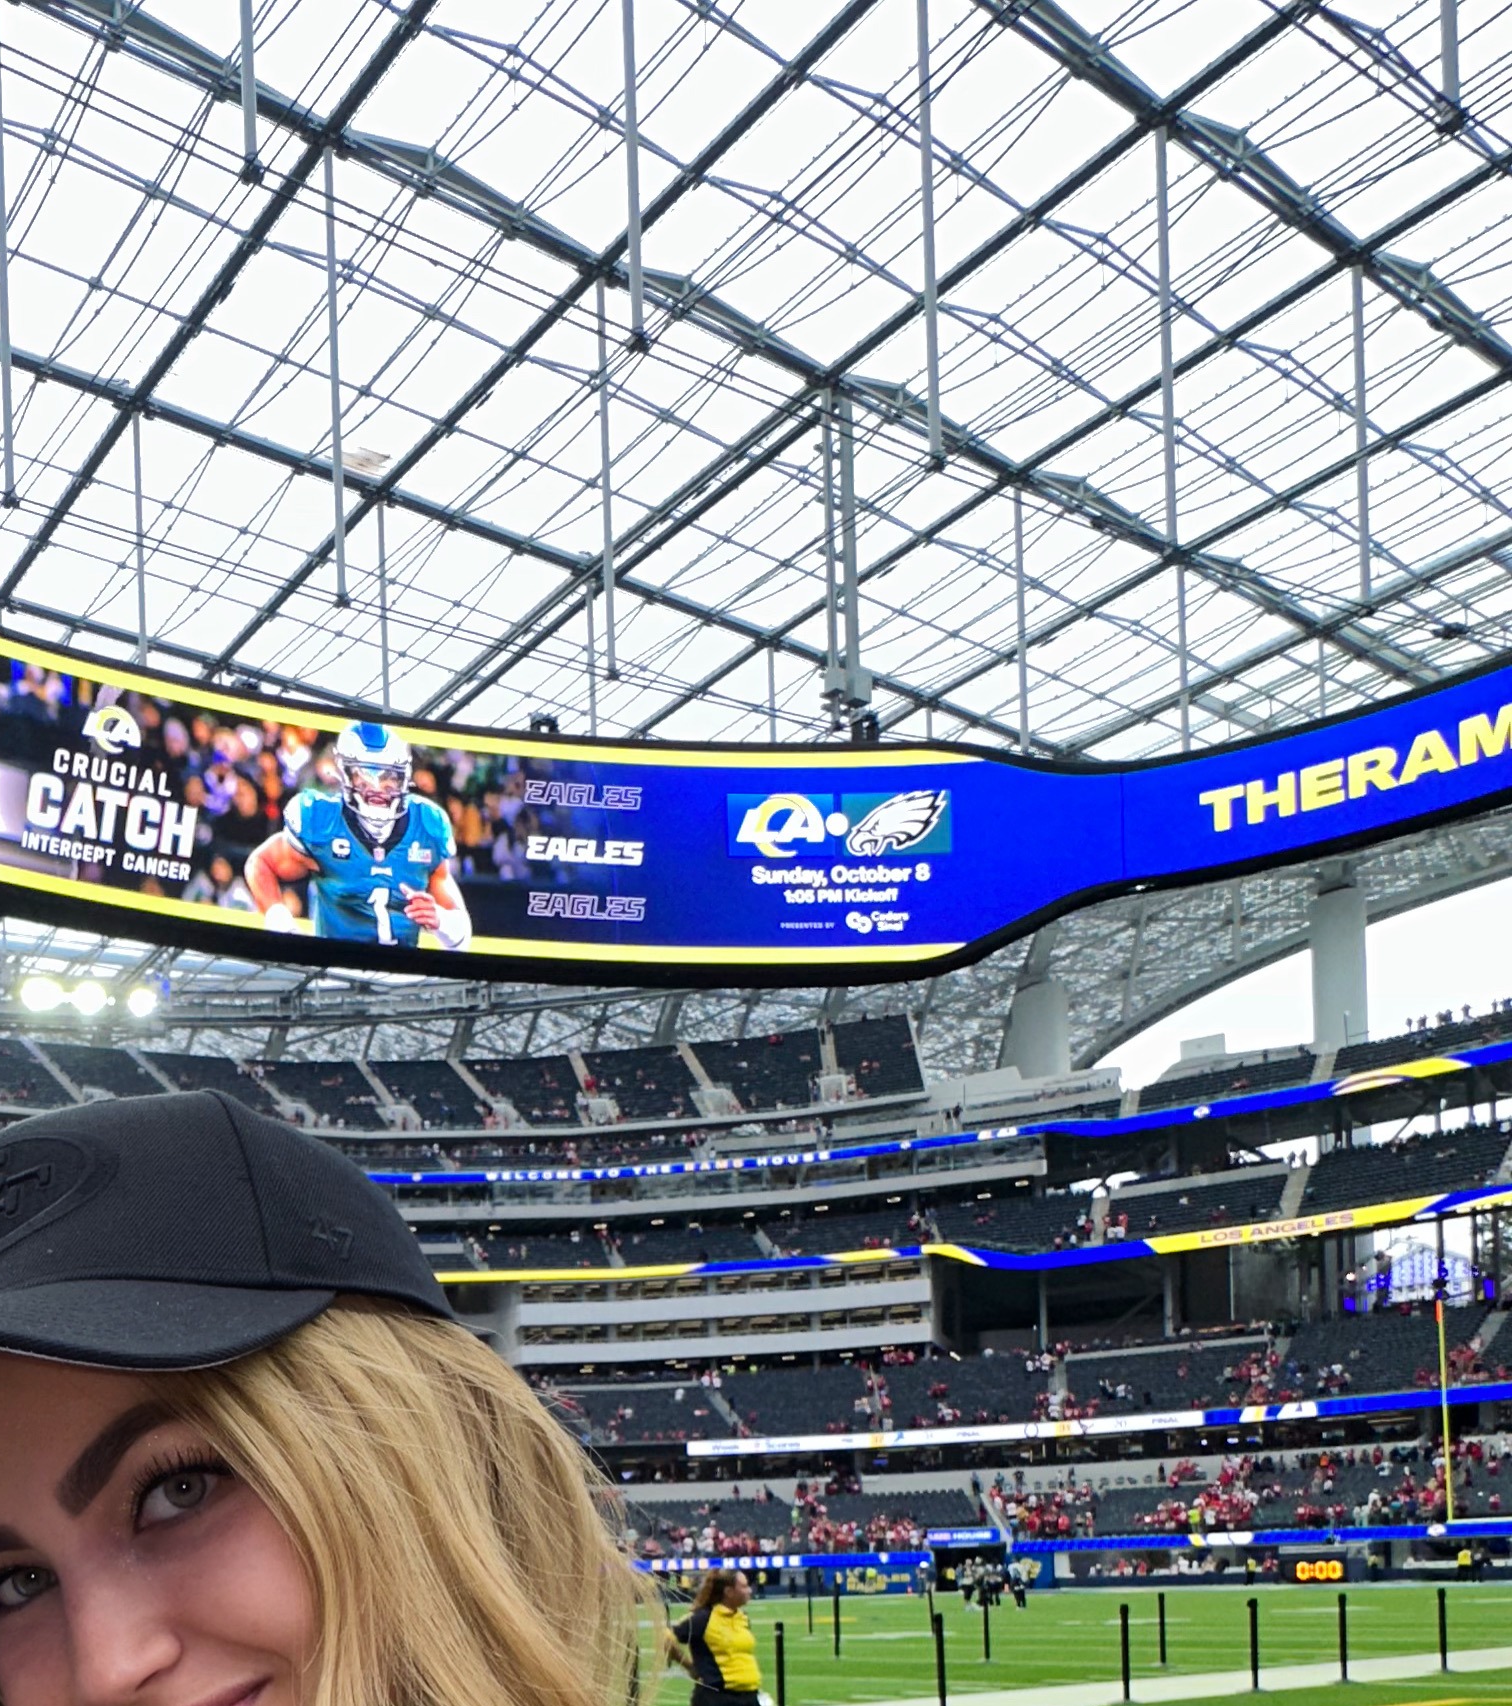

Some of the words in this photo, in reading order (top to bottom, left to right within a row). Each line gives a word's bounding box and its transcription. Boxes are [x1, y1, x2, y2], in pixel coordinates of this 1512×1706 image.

[53, 748, 172, 798] CRUCIAL
[1199, 703, 1512, 832] THERAM
[524, 780, 643, 811] EAGLES
[27, 772, 199, 859] CATCH
[21, 830, 116, 866] INTERCEPT
[122, 851, 191, 881] CANCER
[526, 835, 645, 866] EAGLES
[751, 865, 828, 887] Sunday,
[831, 864, 912, 884] October
[915, 862, 931, 882] 8
[527, 892, 646, 921] EAGLES
[817, 889, 843, 903] PM
[845, 887, 899, 903] Kickoff
[367, 886, 398, 945] 1
[486, 1169, 581, 1181] WELCOME
[594, 1168, 619, 1178] TO
[1200, 1230, 1243, 1244] LOS
[1250, 1213, 1355, 1237] ANGELES
[1296, 1560, 1343, 1580] 0:00
